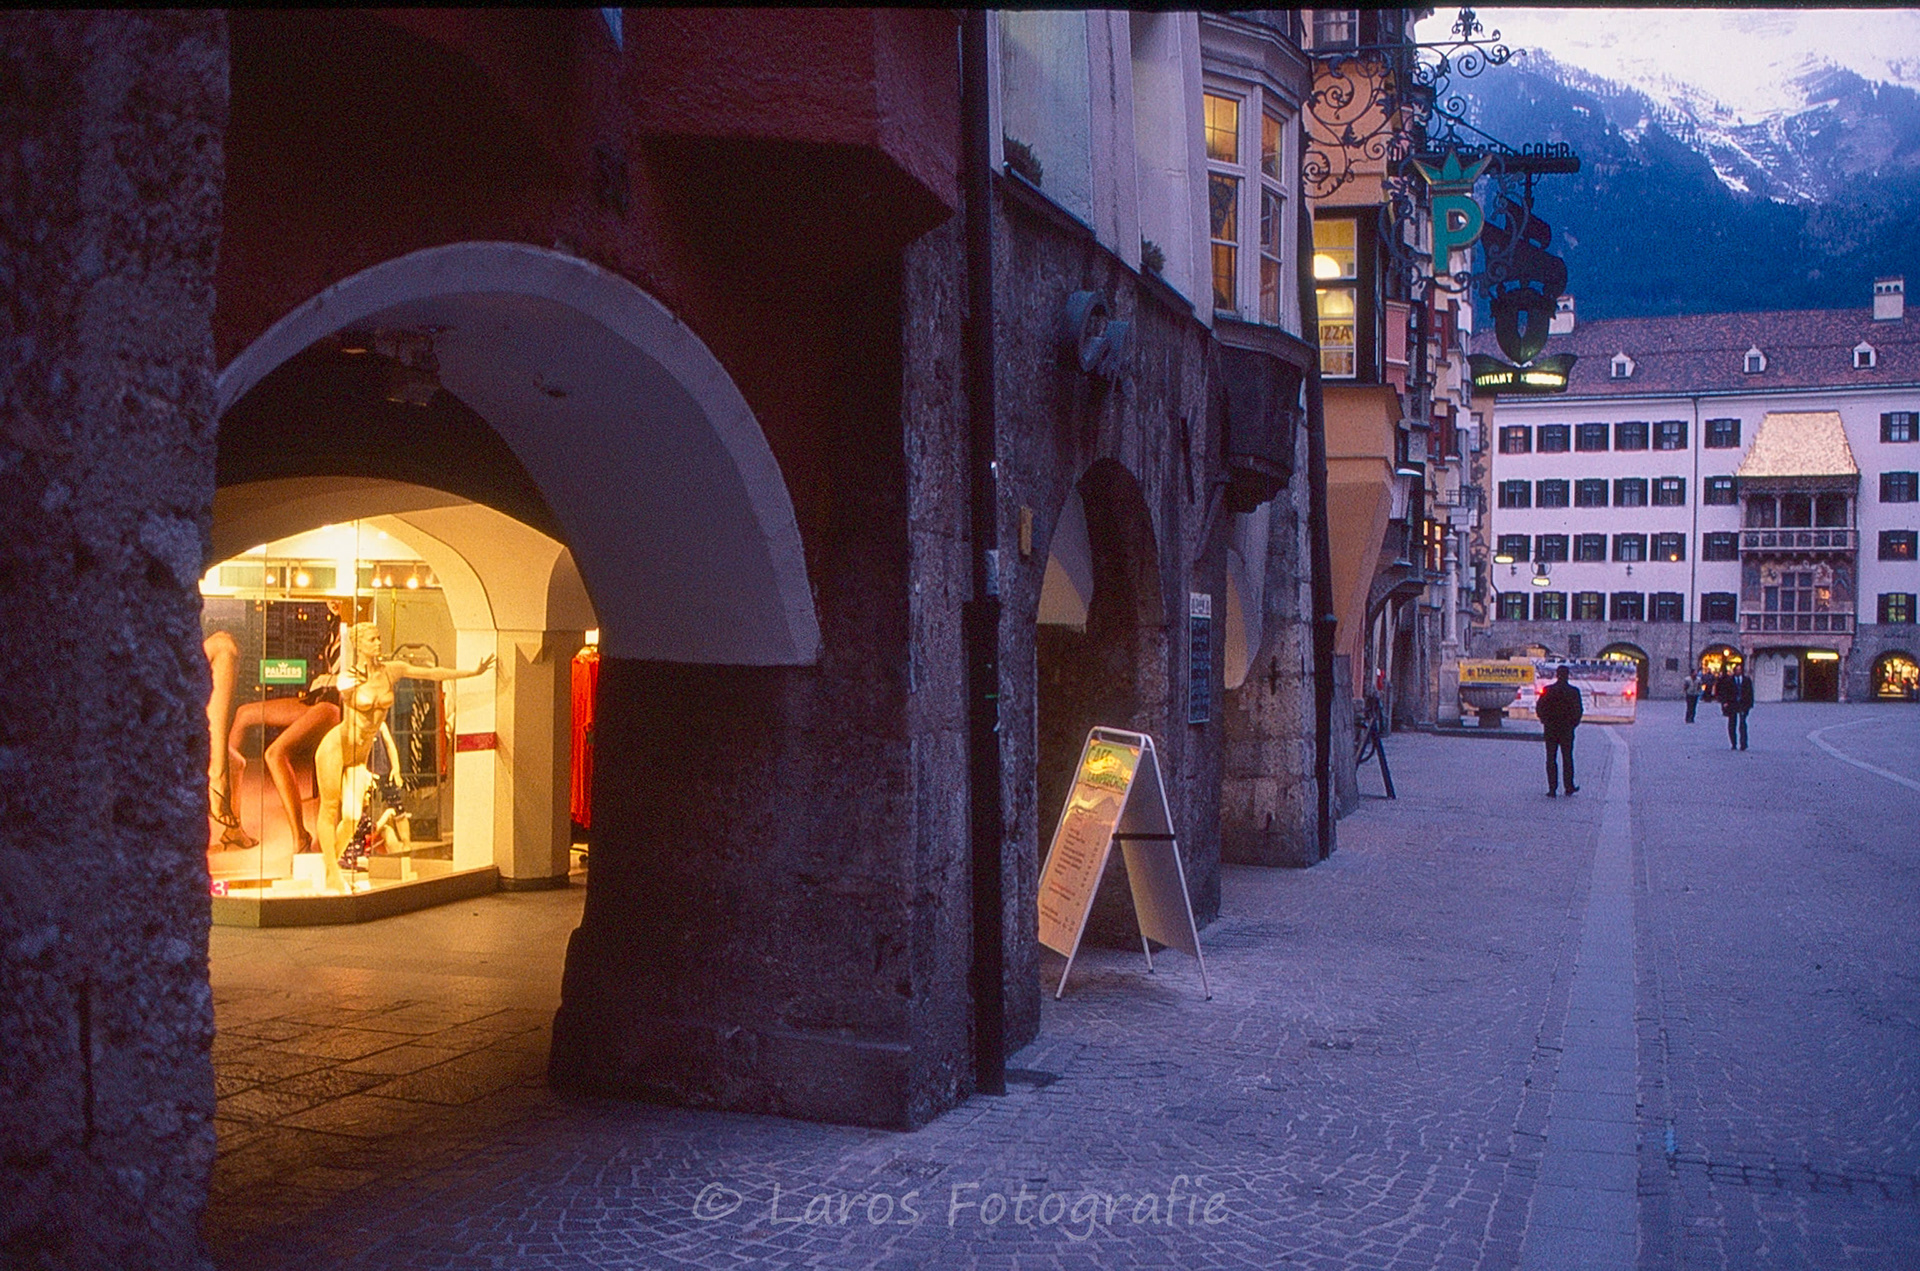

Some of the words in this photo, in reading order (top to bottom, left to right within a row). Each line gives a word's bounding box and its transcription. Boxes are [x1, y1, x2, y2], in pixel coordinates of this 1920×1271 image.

[1430, 193, 1485, 277] P
[1320, 325, 1350, 340] IZZA
[265, 666, 302, 677] PALMERS
